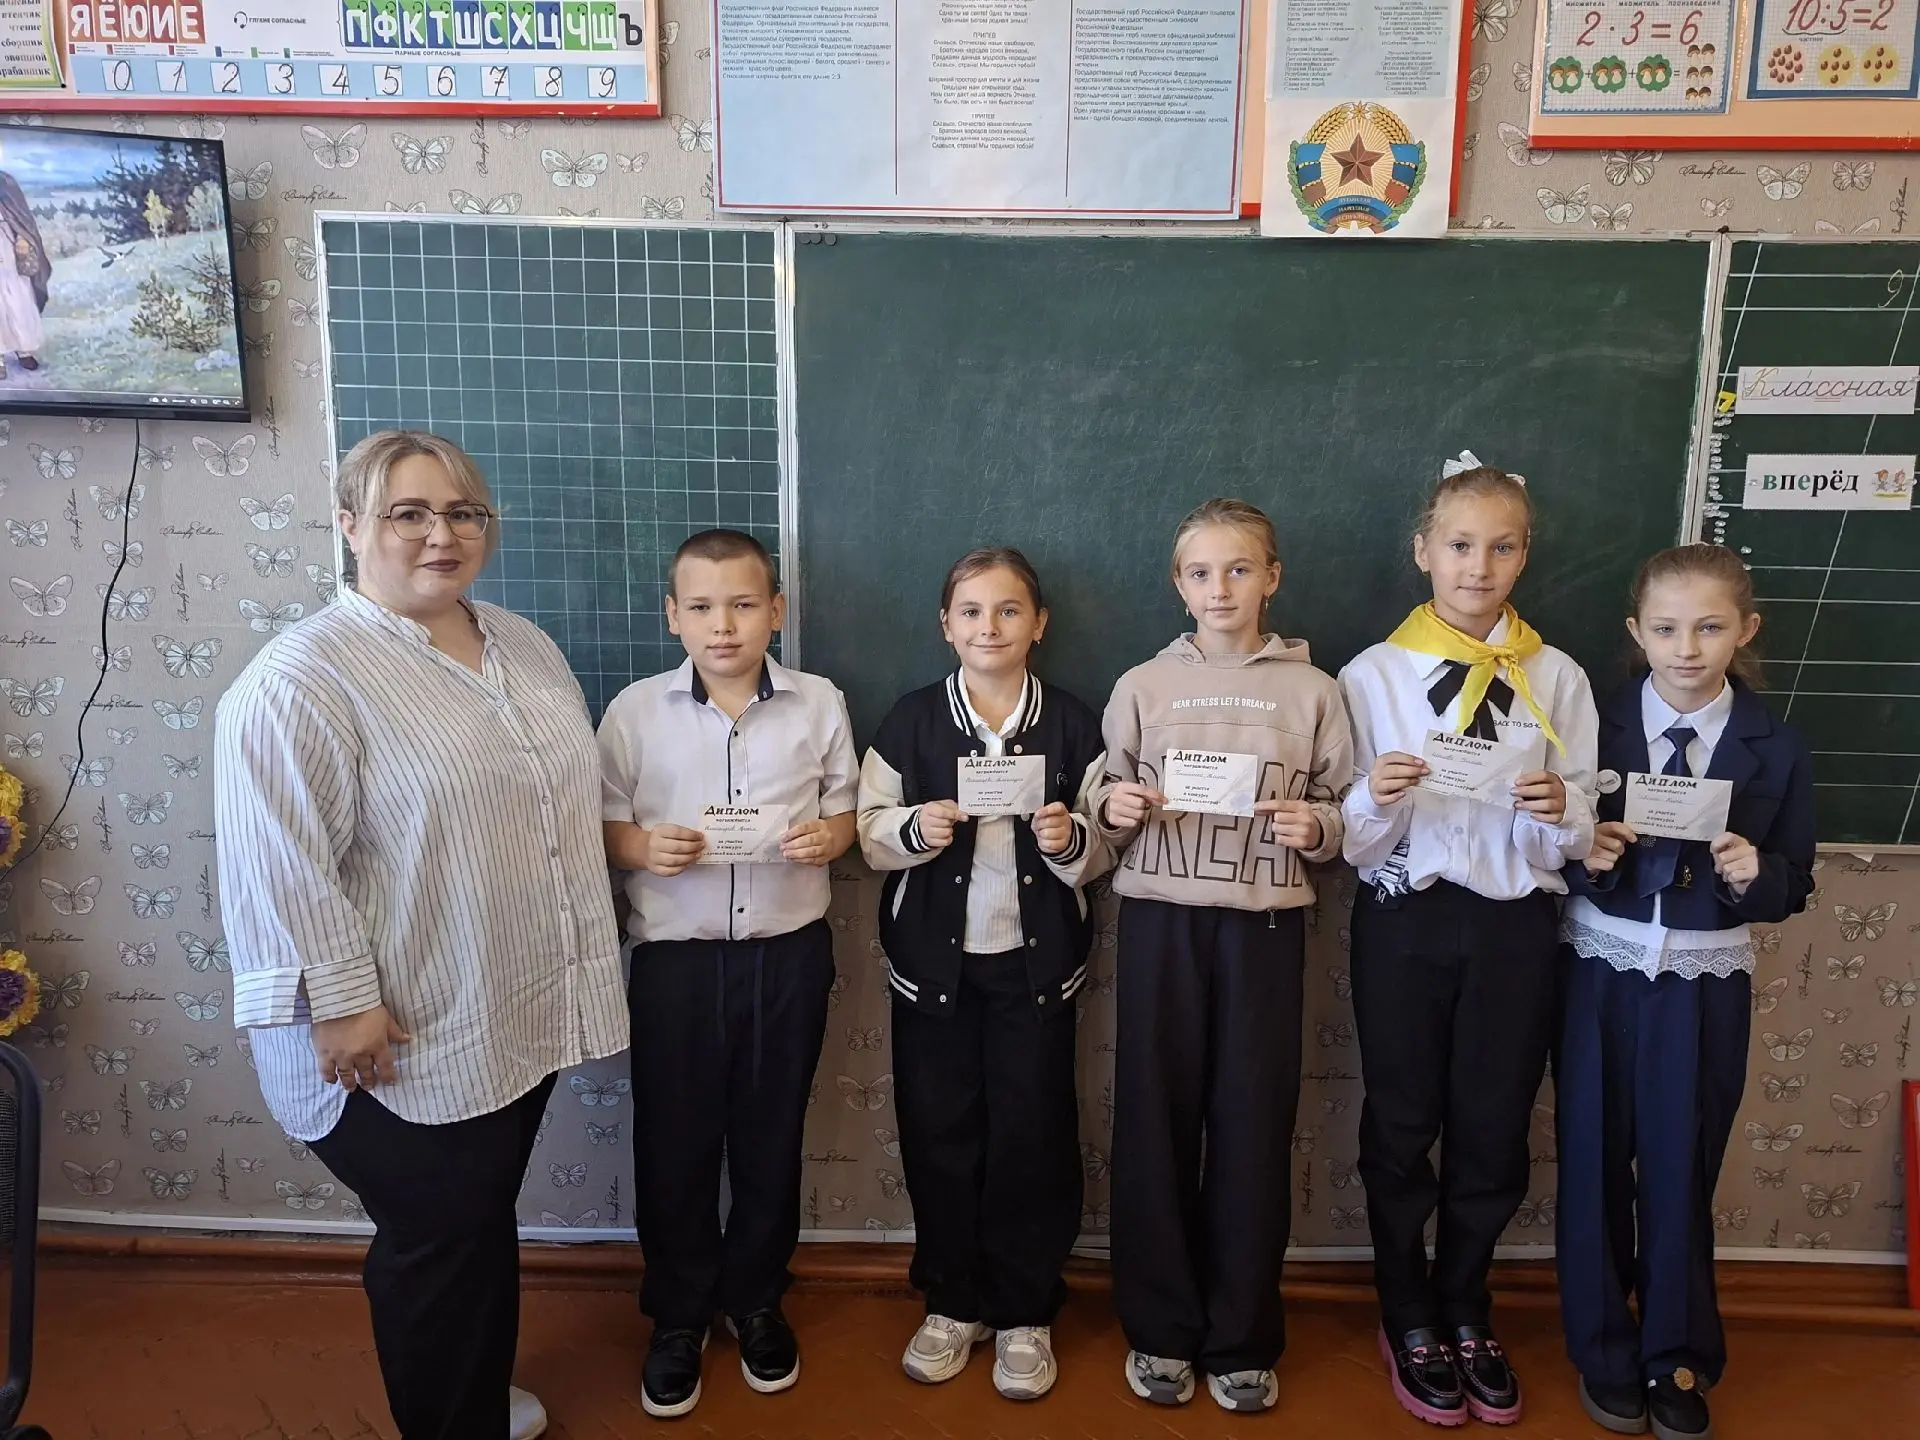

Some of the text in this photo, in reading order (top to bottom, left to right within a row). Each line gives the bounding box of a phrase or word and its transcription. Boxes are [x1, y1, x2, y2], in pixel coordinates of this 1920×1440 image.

[346, 10, 643, 49] П Ф К Т Ш С Х Ц Ч Щ Ъ
[113, 60, 616, 97] 0 1 2 3 4 5 6 7 8 9
[1877, 268, 1904, 308] 9
[1762, 469, 1860, 498] вперёд
[1172, 699, 1190, 709] DEAR
[1192, 697, 1219, 707] STRESS
[1241, 698, 1265, 711] BREAK
[1266, 701, 1277, 711] UP
